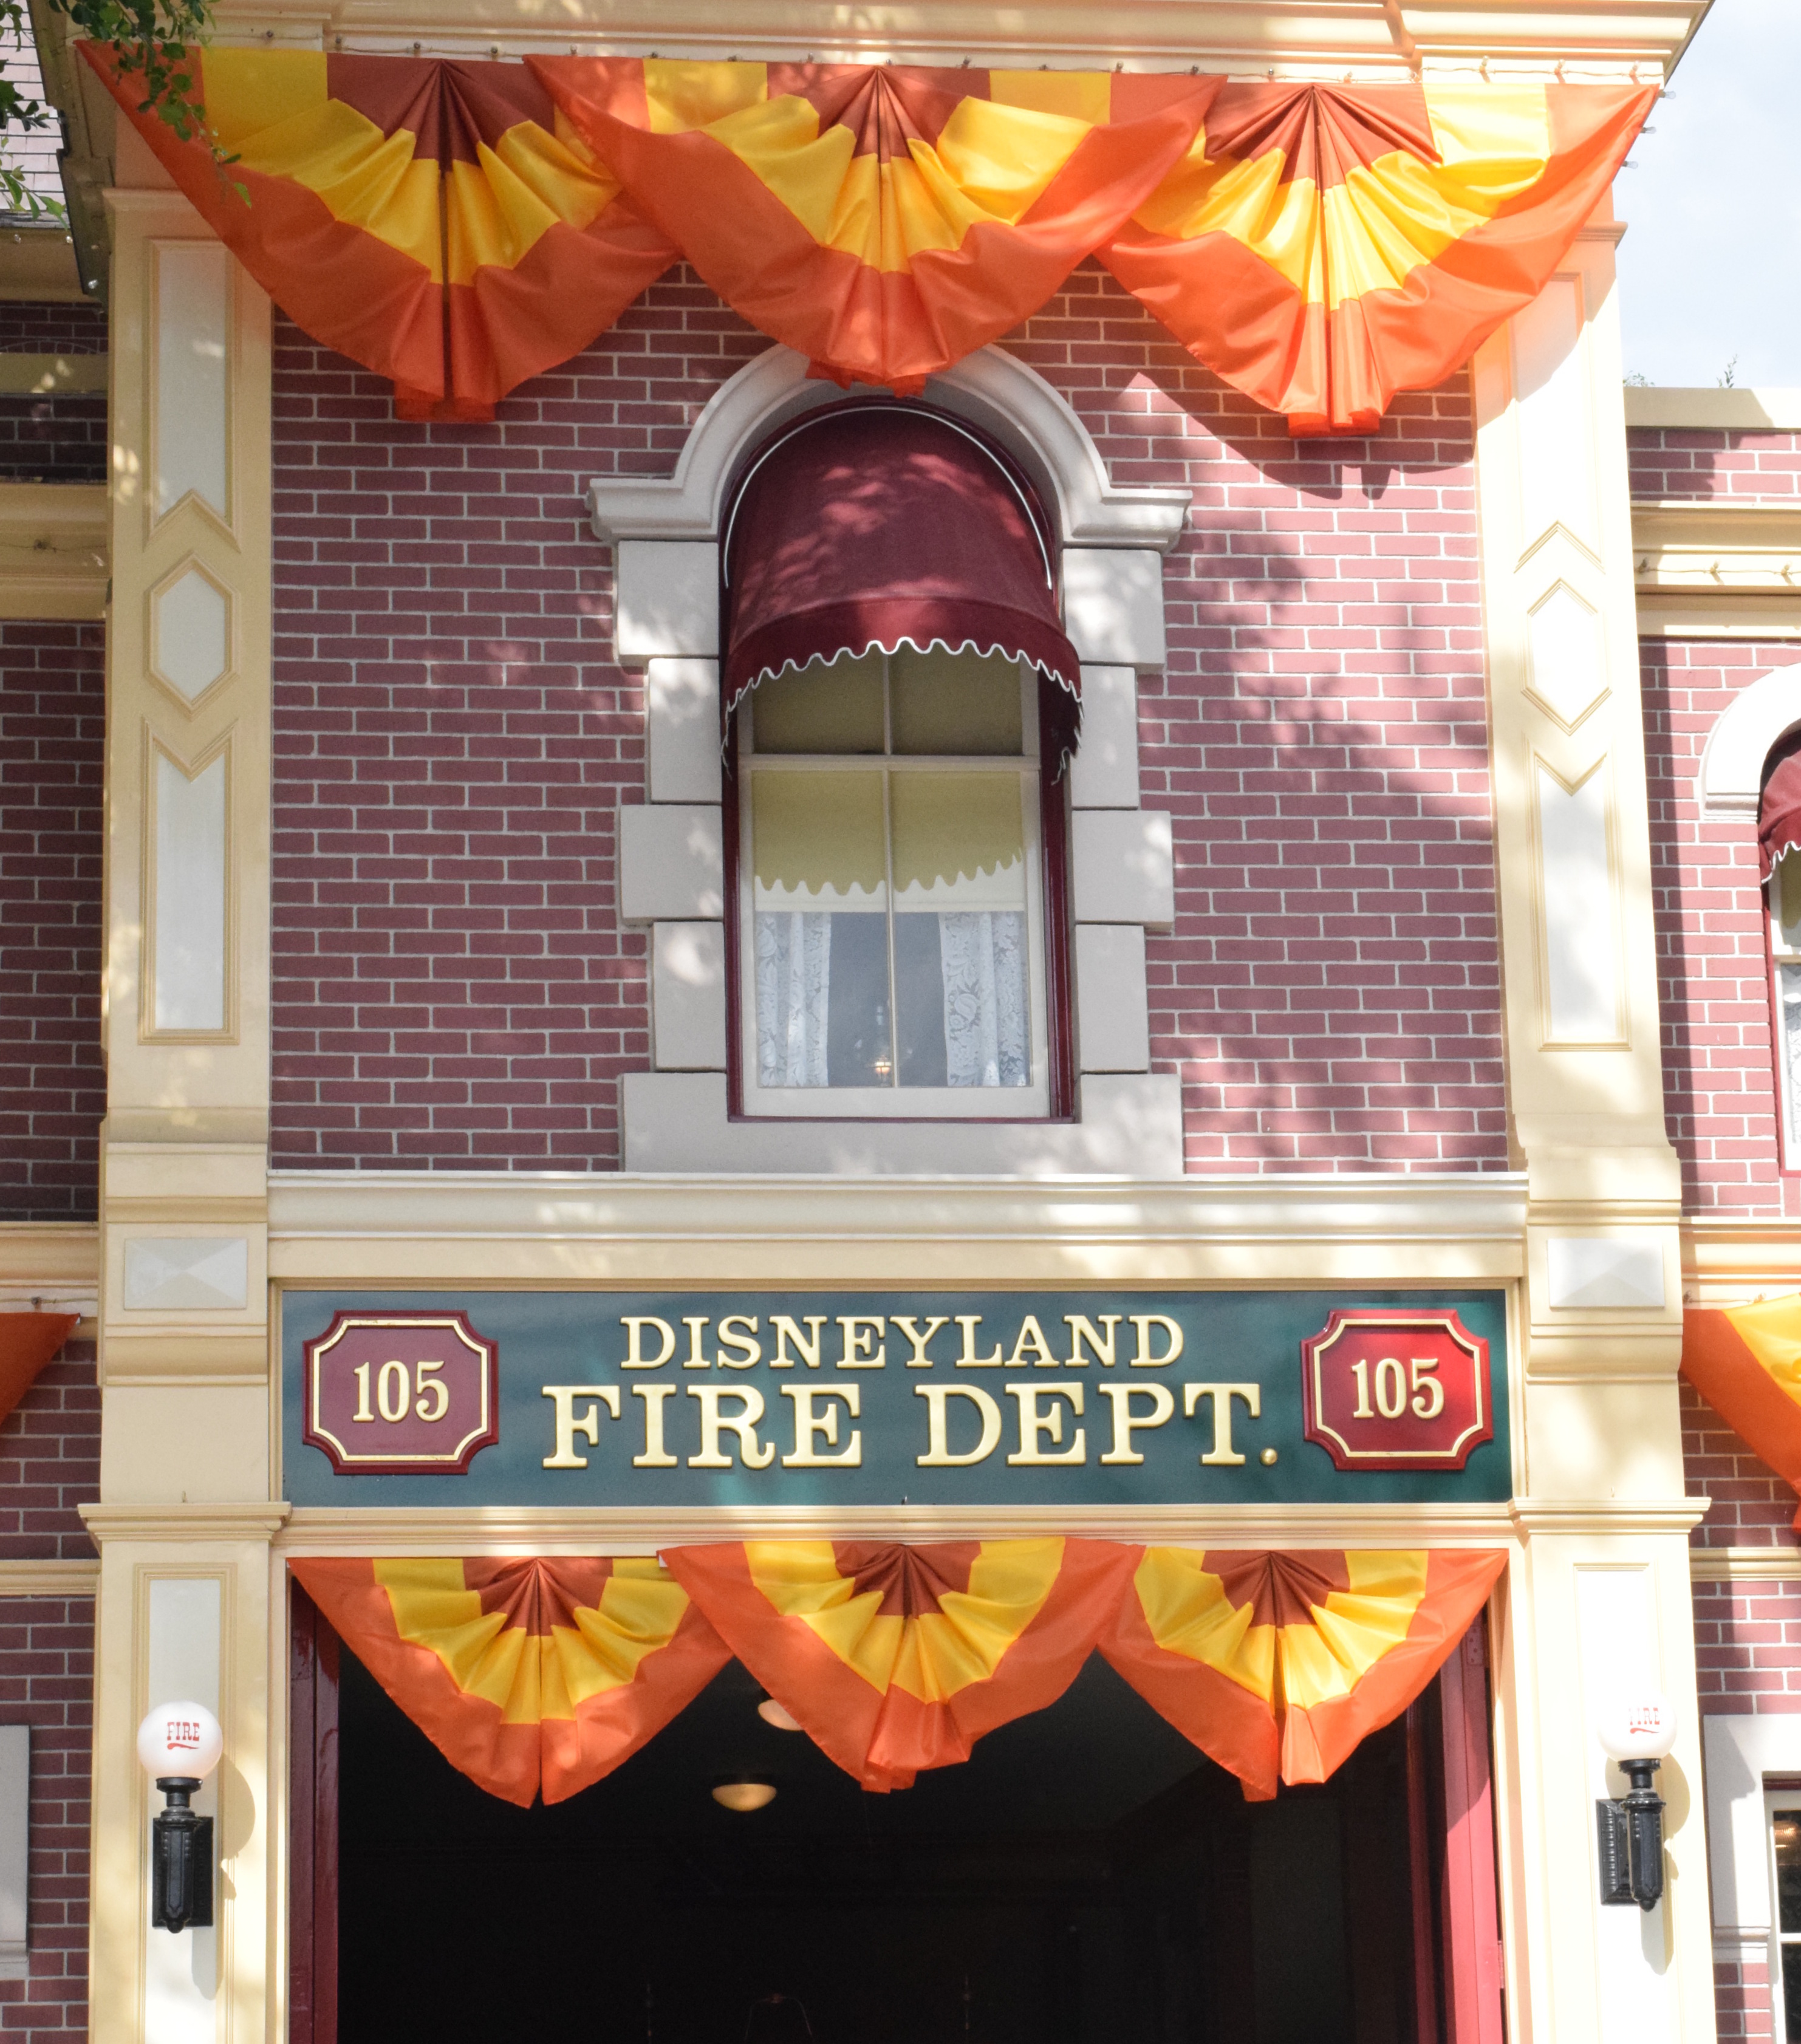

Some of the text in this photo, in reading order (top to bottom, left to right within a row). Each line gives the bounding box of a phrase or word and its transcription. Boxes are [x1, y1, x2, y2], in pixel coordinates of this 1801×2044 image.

[620, 1314, 1184, 1370] DISNEYLAND
[353, 1360, 449, 1423] 105
[1350, 1358, 1444, 1420] 105
[542, 1382, 1278, 1470] FIRE DEPT.
[167, 1721, 200, 1742] FIRE
